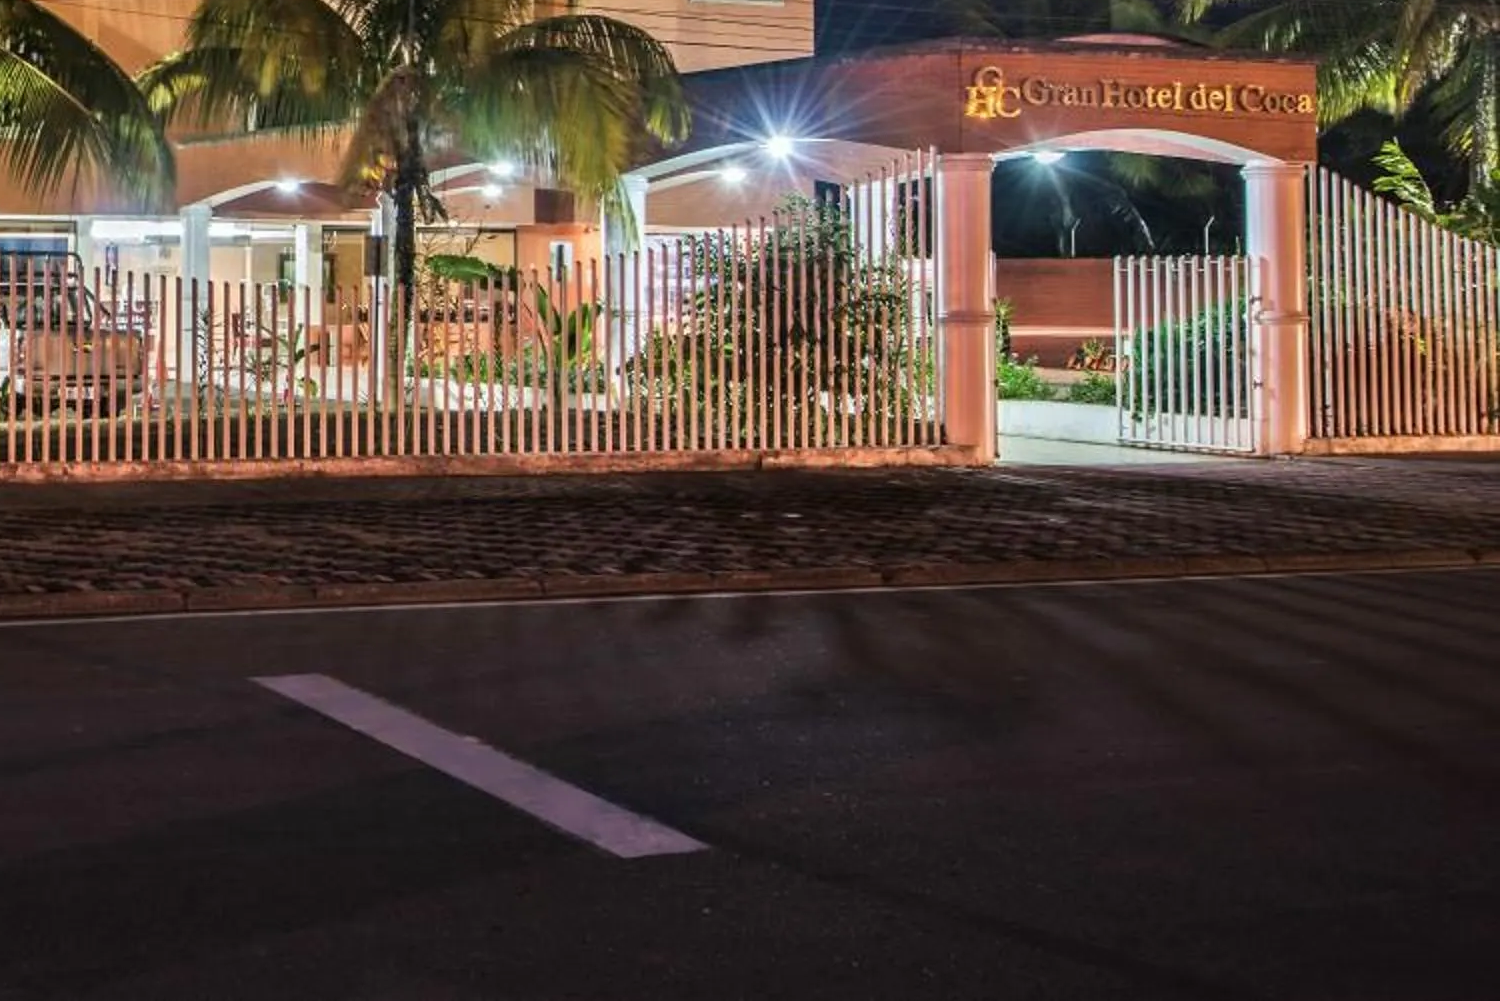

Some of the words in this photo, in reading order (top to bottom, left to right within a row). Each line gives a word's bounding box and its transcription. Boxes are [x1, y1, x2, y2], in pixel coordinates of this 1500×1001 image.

[1020, 77, 1099, 107] Gran
[1100, 78, 1184, 111] Hotel
[1189, 82, 1236, 113] del
[1239, 84, 1315, 114] Coca
